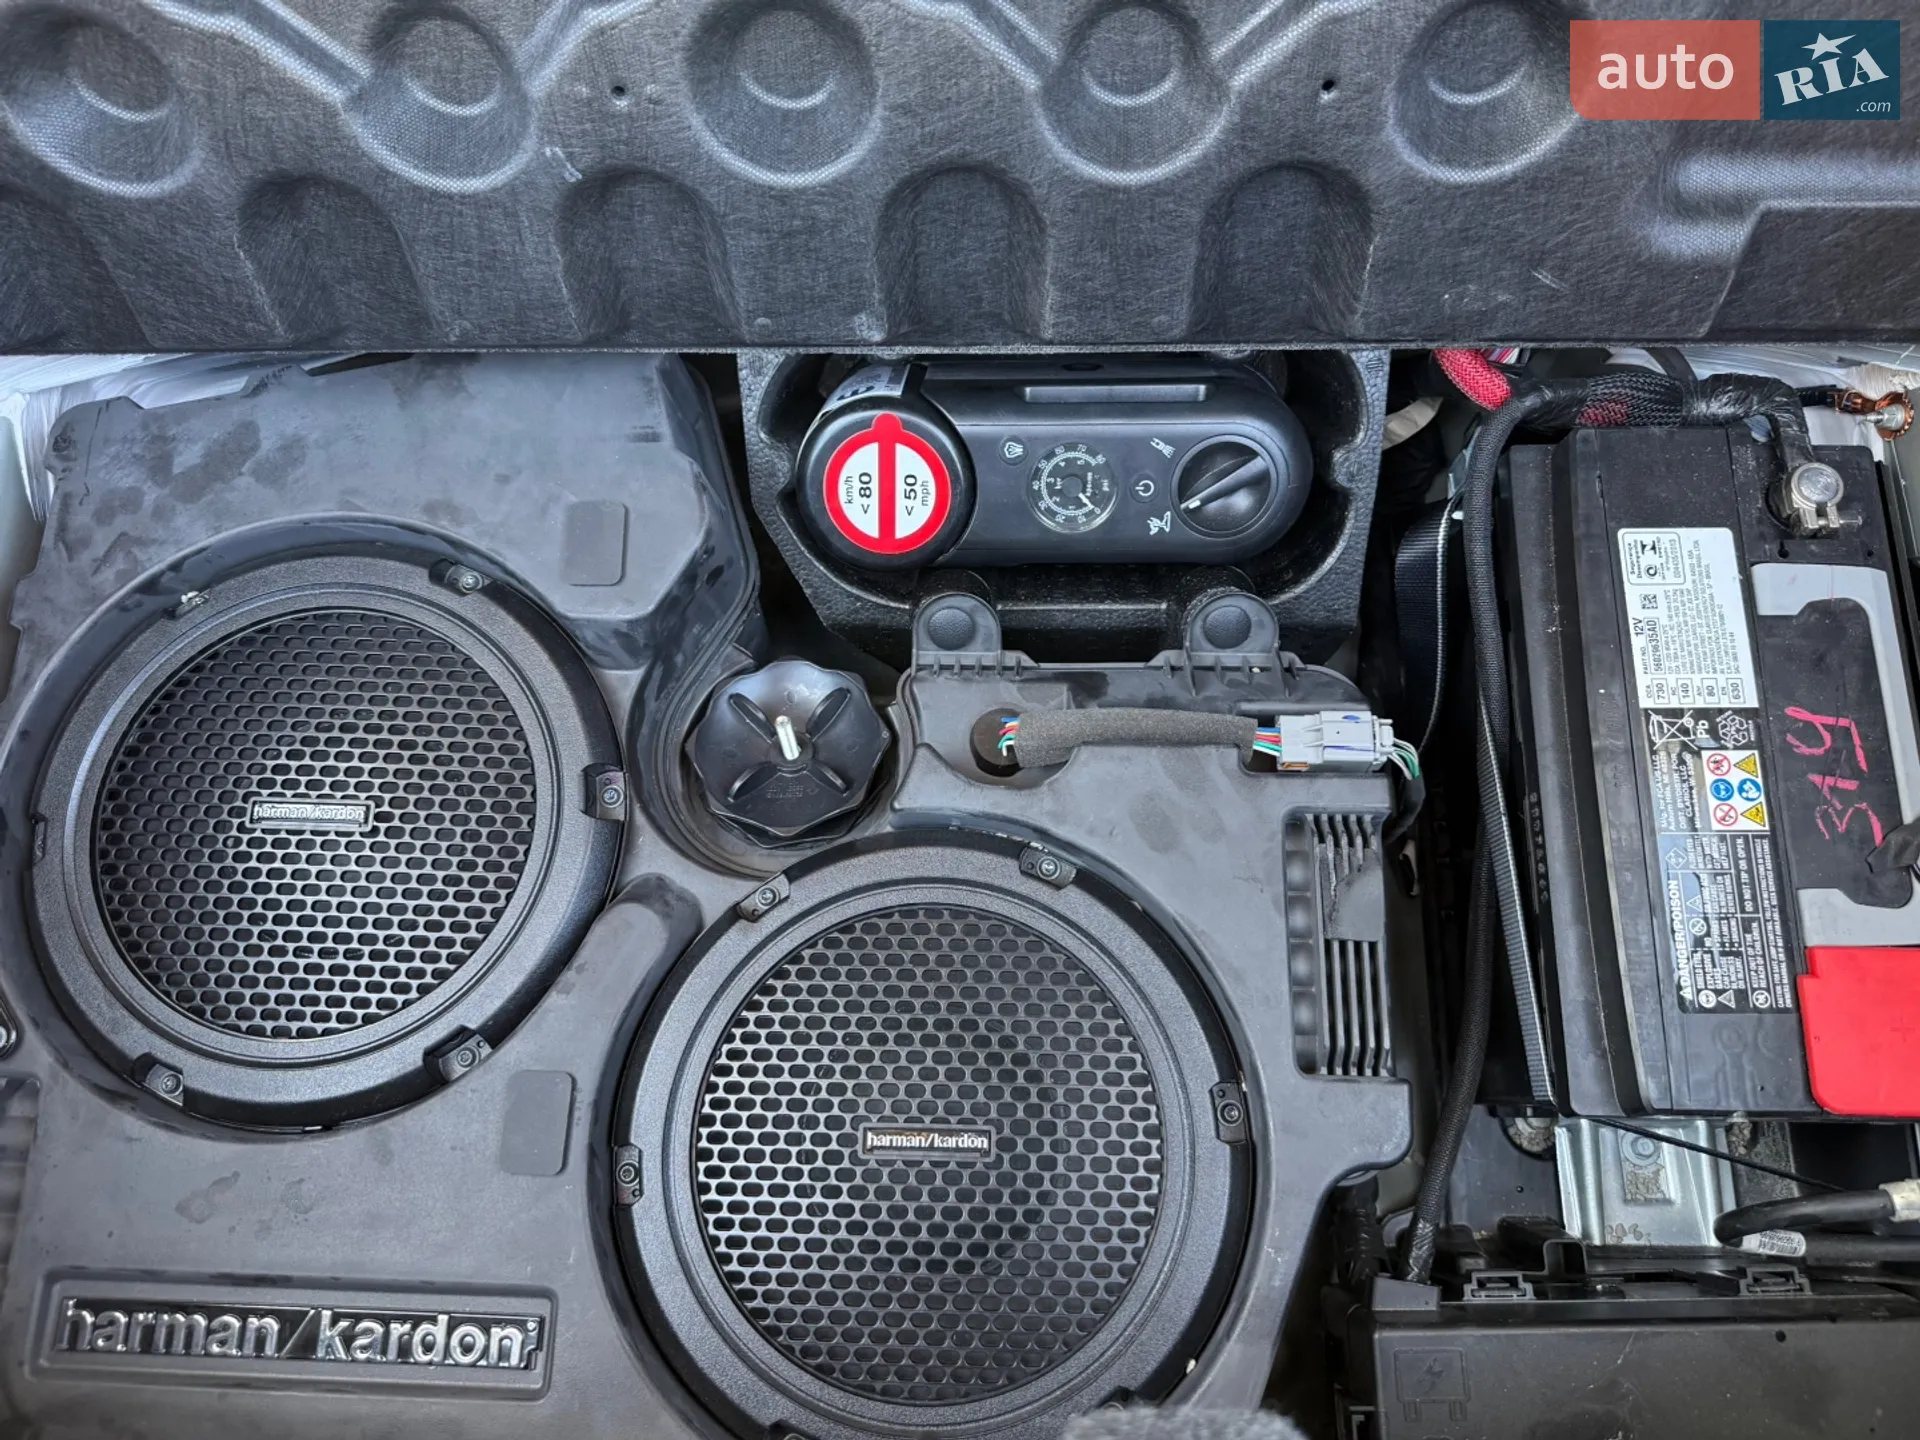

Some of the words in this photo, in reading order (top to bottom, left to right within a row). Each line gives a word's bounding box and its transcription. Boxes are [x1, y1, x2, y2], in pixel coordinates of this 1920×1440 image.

[844, 476, 853, 504] km/h
[859, 472, 872, 499] 80
[904, 474, 918, 501] 50
[920, 480, 930, 506] mph
[1632, 617, 1644, 636] 12V
[1655, 682, 1665, 699] 730
[1671, 686, 1676, 695] RC
[1680, 683, 1690, 698] 140
[1705, 685, 1715, 696] 80
[1721, 686, 1726, 695] EN
[1730, 682, 1740, 699] 630
[1695, 720, 1710, 738] Pb
[1651, 754, 1660, 769] LLC
[1679, 764, 1688, 779] LLC
[252, 802, 365, 821] harman/kardon
[1738, 859, 1748, 870] OR
[1739, 870, 1749, 882] TIP
[1741, 885, 1751, 899] NOT
[1743, 900, 1753, 911] DO
[1668, 880, 1690, 985] DANGER/POISON
[1744, 933, 1753, 946] THE
[1703, 937, 1712, 946] NO
[1746, 947, 1754, 955] OF
[1747, 956, 1756, 970] OUT
[1755, 956, 1763, 964] OF
[1749, 971, 1758, 987] KEEP
[1757, 965, 1766, 987] REACH
[867, 1130, 988, 1148] harman/kardon
[57, 1298, 530, 1369] harman/kardon
